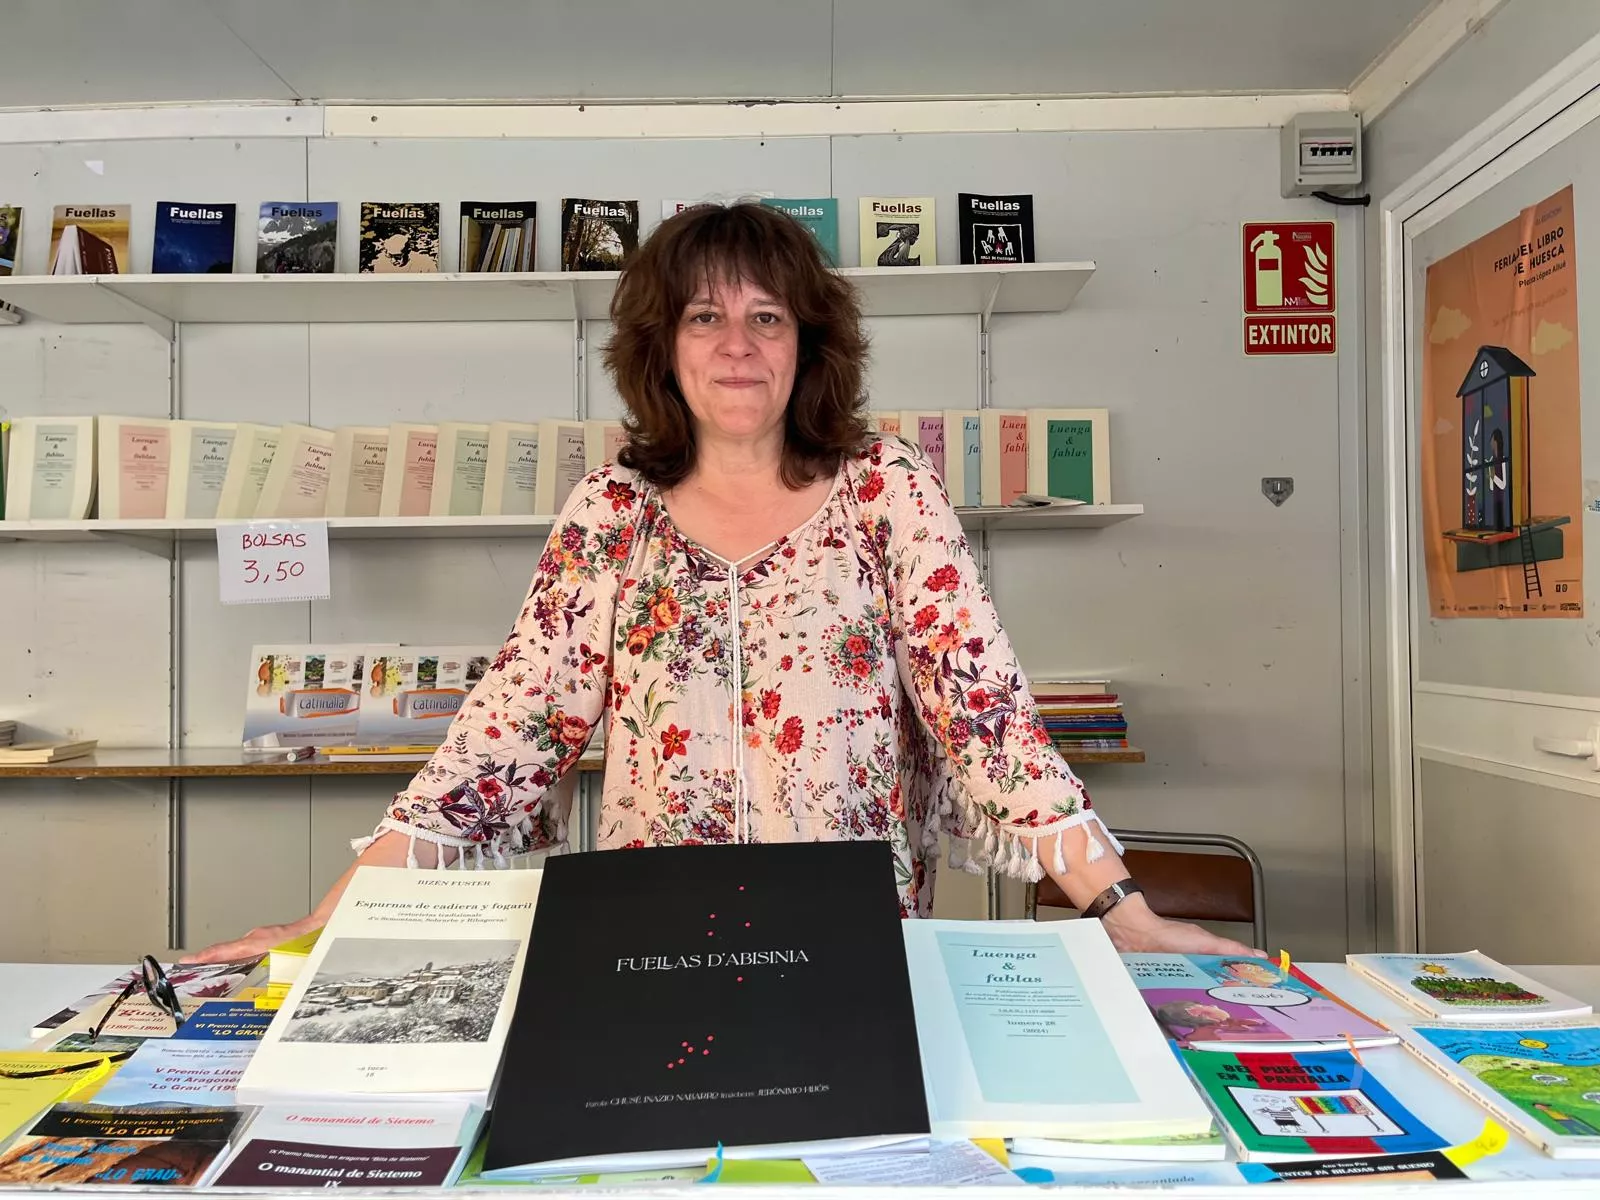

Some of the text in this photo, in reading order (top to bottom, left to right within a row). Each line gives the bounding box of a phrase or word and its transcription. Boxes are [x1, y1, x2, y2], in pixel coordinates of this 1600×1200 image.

[573, 204, 626, 218] Fuellas
[872, 202, 923, 215] Fuellas
[971, 199, 1021, 212] Fuellas
[64, 207, 116, 220] Fuellas
[169, 207, 224, 221] Fuellas
[270, 206, 323, 218] Fuellas
[372, 207, 425, 219] Fuellas
[472, 207, 524, 219] Fuellas
[1494, 252, 1517, 273] FERIA
[1537, 226, 1564, 249] LIBRO
[1530, 243, 1565, 270] HUESCA
[1248, 324, 1332, 345] EXTINTOR
[1048, 424, 1091, 436] Luenga
[45, 435, 67, 443] Luenga
[131, 436, 159, 445] Luenga
[202, 437, 228, 447] Luenga
[1016, 432, 1024, 441] &
[1065, 436, 1074, 445] &
[307, 446, 332, 457] Luenga
[1004, 442, 1027, 454] fabl
[1052, 447, 1087, 459] fablas
[304, 461, 326, 471] fablas
[242, 533, 307, 551] BOLSAS
[243, 560, 305, 584] 3,50
[450, 880, 492, 888] FUSTER
[354, 900, 413, 910] Espurnas
[415, 902, 430, 910] de
[431, 902, 478, 910] cadiera
[491, 902, 534, 911] fogaril
[971, 949, 1038, 960] Luenga
[616, 949, 810, 972] FUELLAS D'ABISINIA
[1001, 961, 1017, 971] &
[985, 973, 1043, 984] fablas
[154, 1067, 164, 1075] V
[168, 1068, 210, 1076] Premio
[1263, 1074, 1352, 1084] PANTALLA
[147, 1082, 168, 1091] "Lo
[168, 1082, 209, 1091] Grau"
[73, 1118, 112, 1126] Premio
[113, 1119, 159, 1127] Literario
[175, 1117, 224, 1125] Aragonés
[298, 1115, 366, 1125] manantial
[366, 1117, 382, 1125] de
[384, 1117, 436, 1125] Sietemo
[100, 1125, 185, 1136] "Lo Grau"
[257, 1161, 423, 1179] O manantial de Sietemo
[1377, 1164, 1396, 1172] SIN
